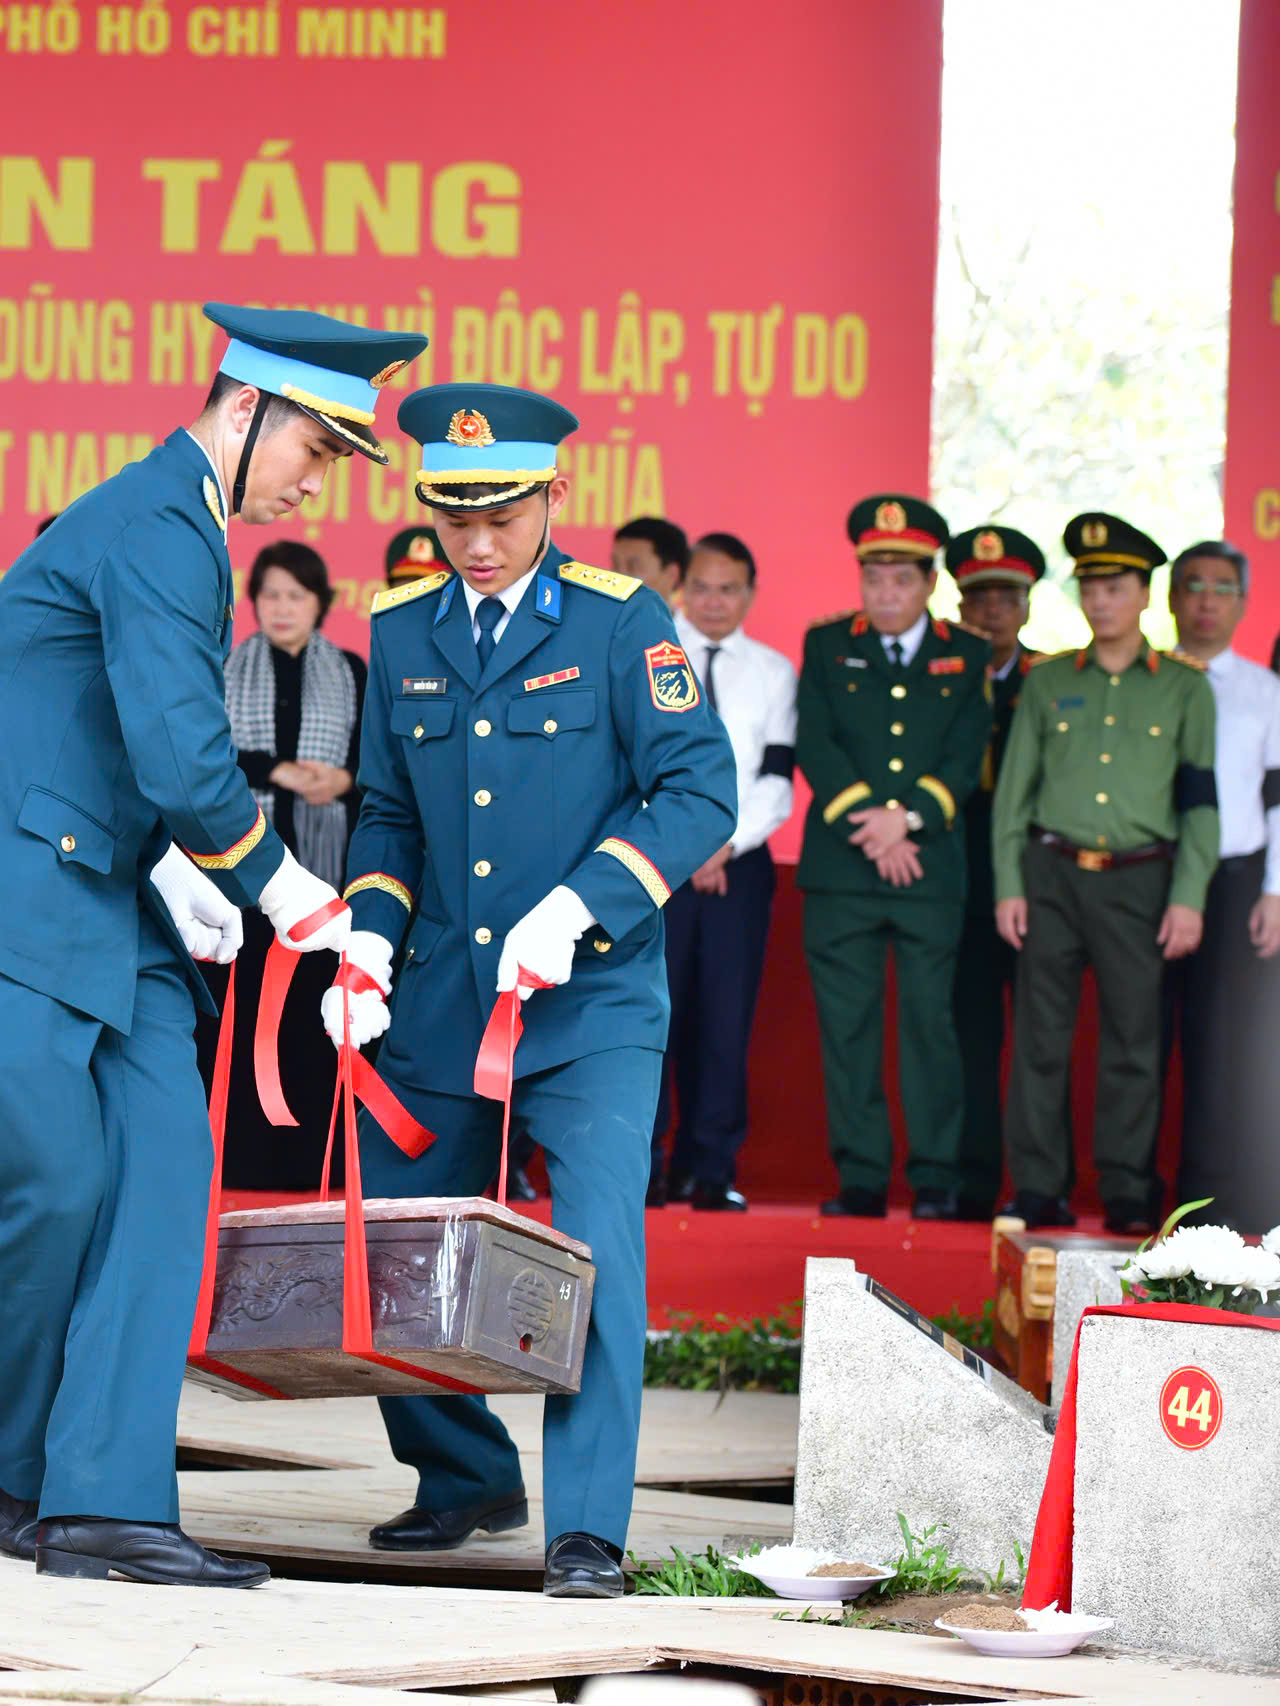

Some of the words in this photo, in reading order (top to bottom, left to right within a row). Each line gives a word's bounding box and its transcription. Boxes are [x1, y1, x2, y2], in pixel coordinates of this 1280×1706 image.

[296, 7, 447, 59] MINH
[142, 138, 523, 259] TÁNG
[578, 289, 690, 413] LẬP,
[707, 303, 785, 417] TỰ
[792, 311, 869, 400] DO
[559, 1280, 571, 1300] 43
[1168, 1385, 1212, 1431] 44
